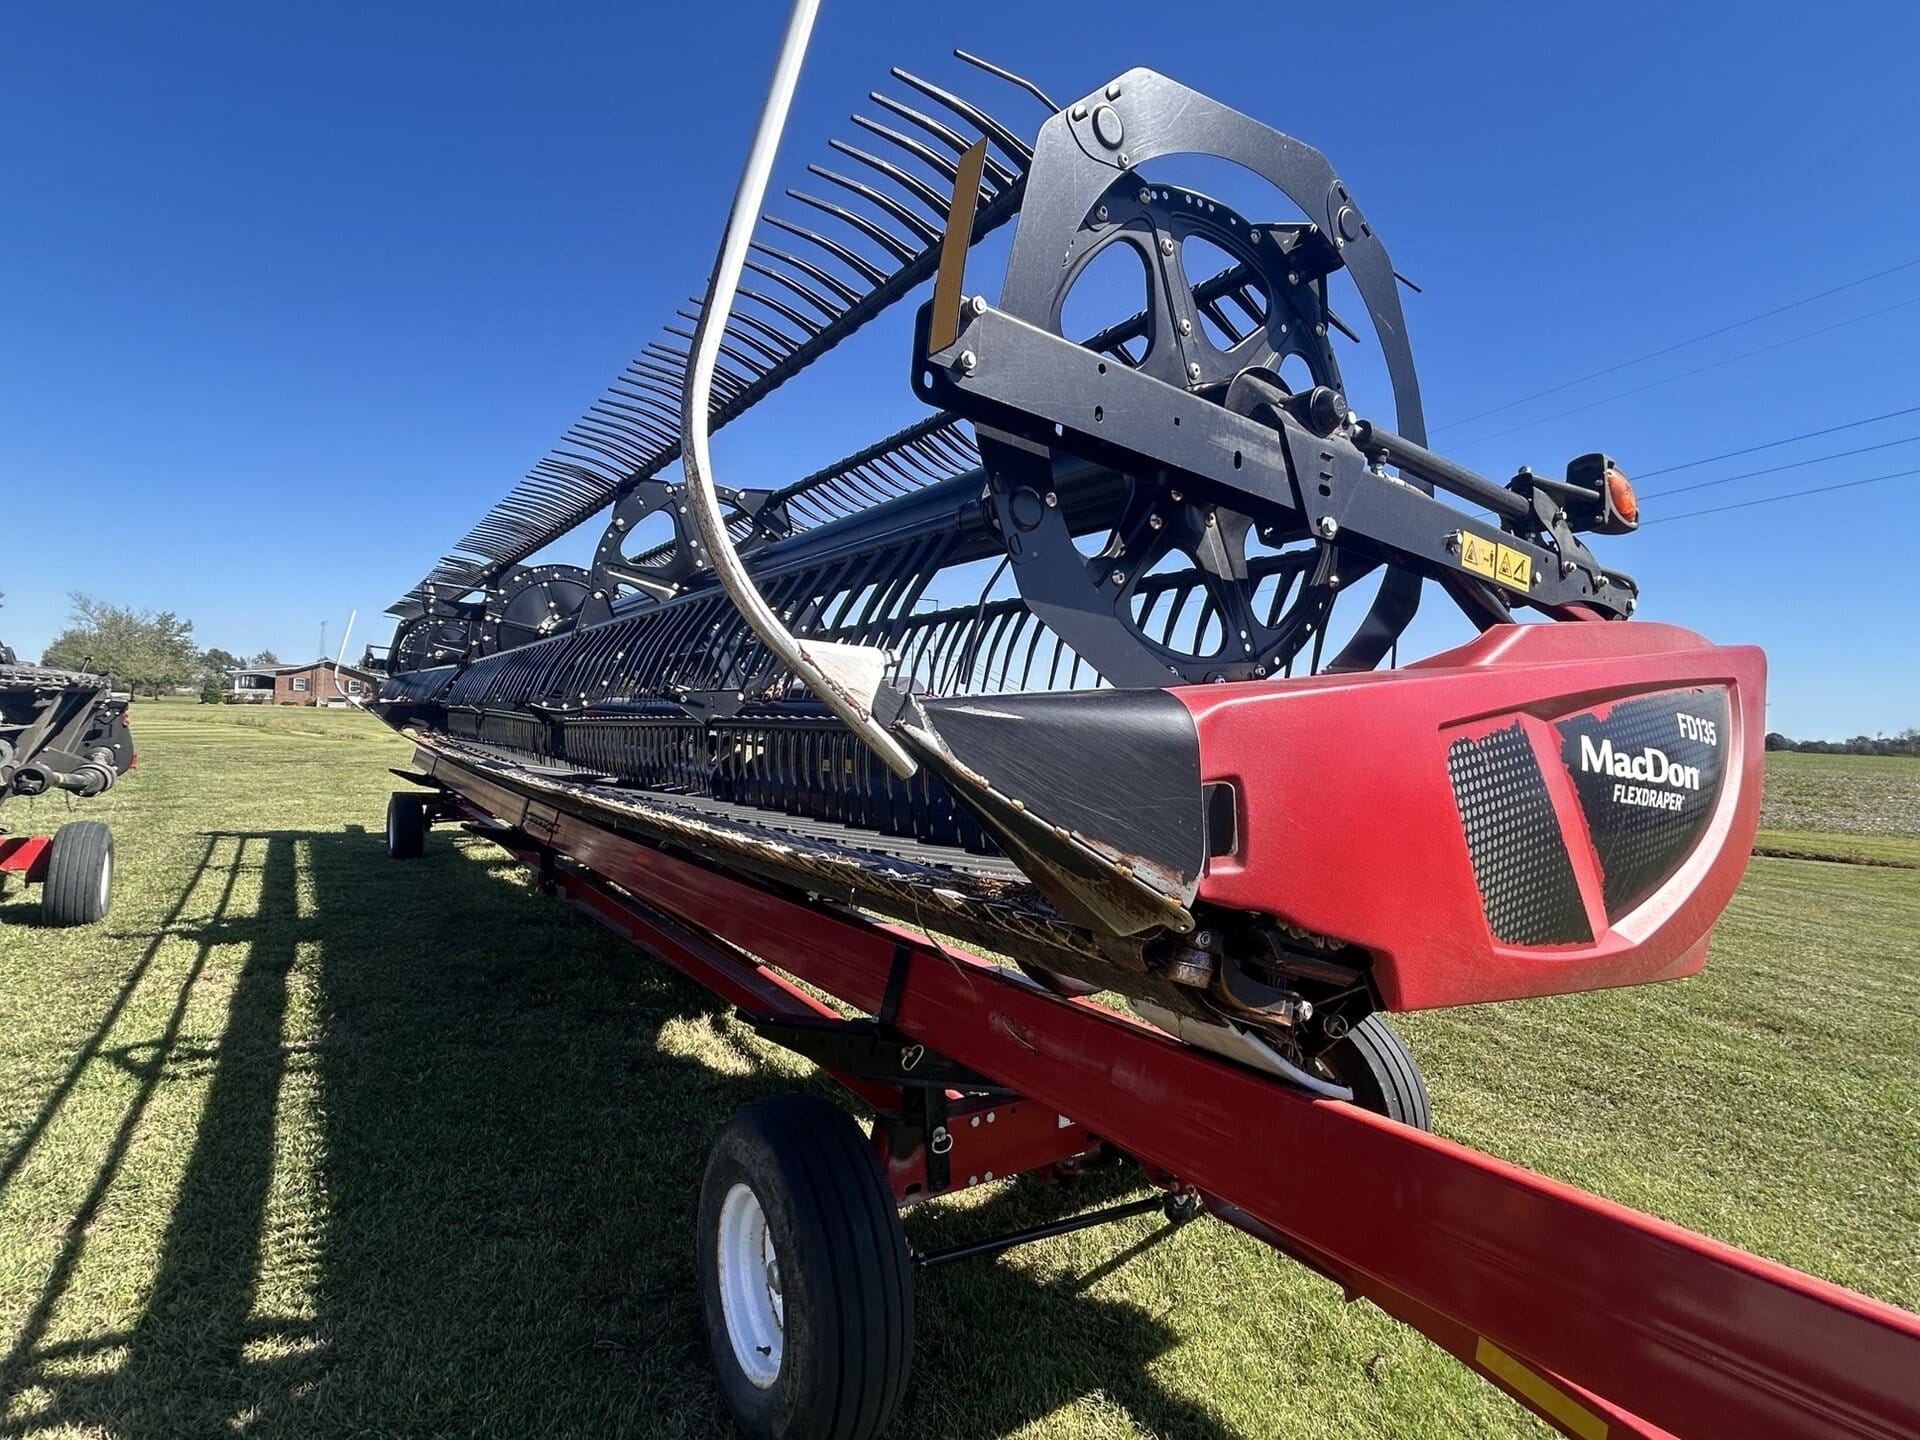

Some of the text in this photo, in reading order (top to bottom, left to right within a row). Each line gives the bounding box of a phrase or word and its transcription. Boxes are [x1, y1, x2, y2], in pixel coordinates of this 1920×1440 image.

[1677, 712, 1717, 746] FD135
[1581, 735, 1699, 790] MacDon
[1613, 784, 1684, 811] FLEXDRAPER
